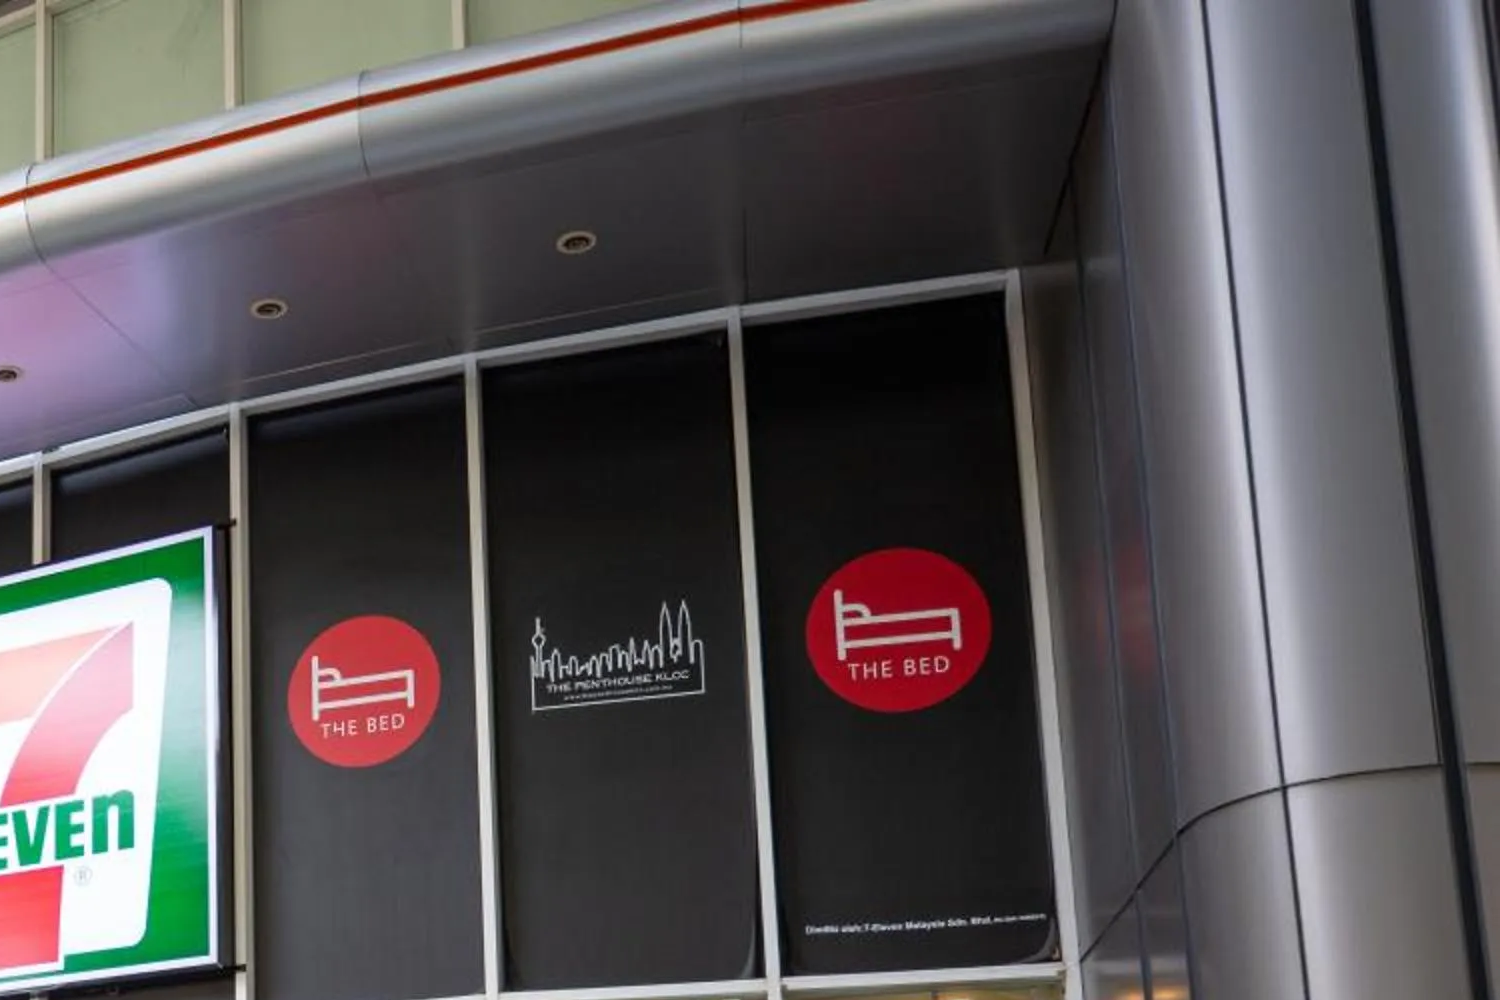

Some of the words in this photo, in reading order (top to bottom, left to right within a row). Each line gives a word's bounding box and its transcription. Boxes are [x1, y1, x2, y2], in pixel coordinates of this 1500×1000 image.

[847, 661, 893, 681] THE
[903, 655, 950, 676] BED
[546, 682, 572, 693] THE
[574, 675, 653, 690] PENTHOUSE
[320, 720, 358, 739] THE
[366, 713, 405, 733] BED
